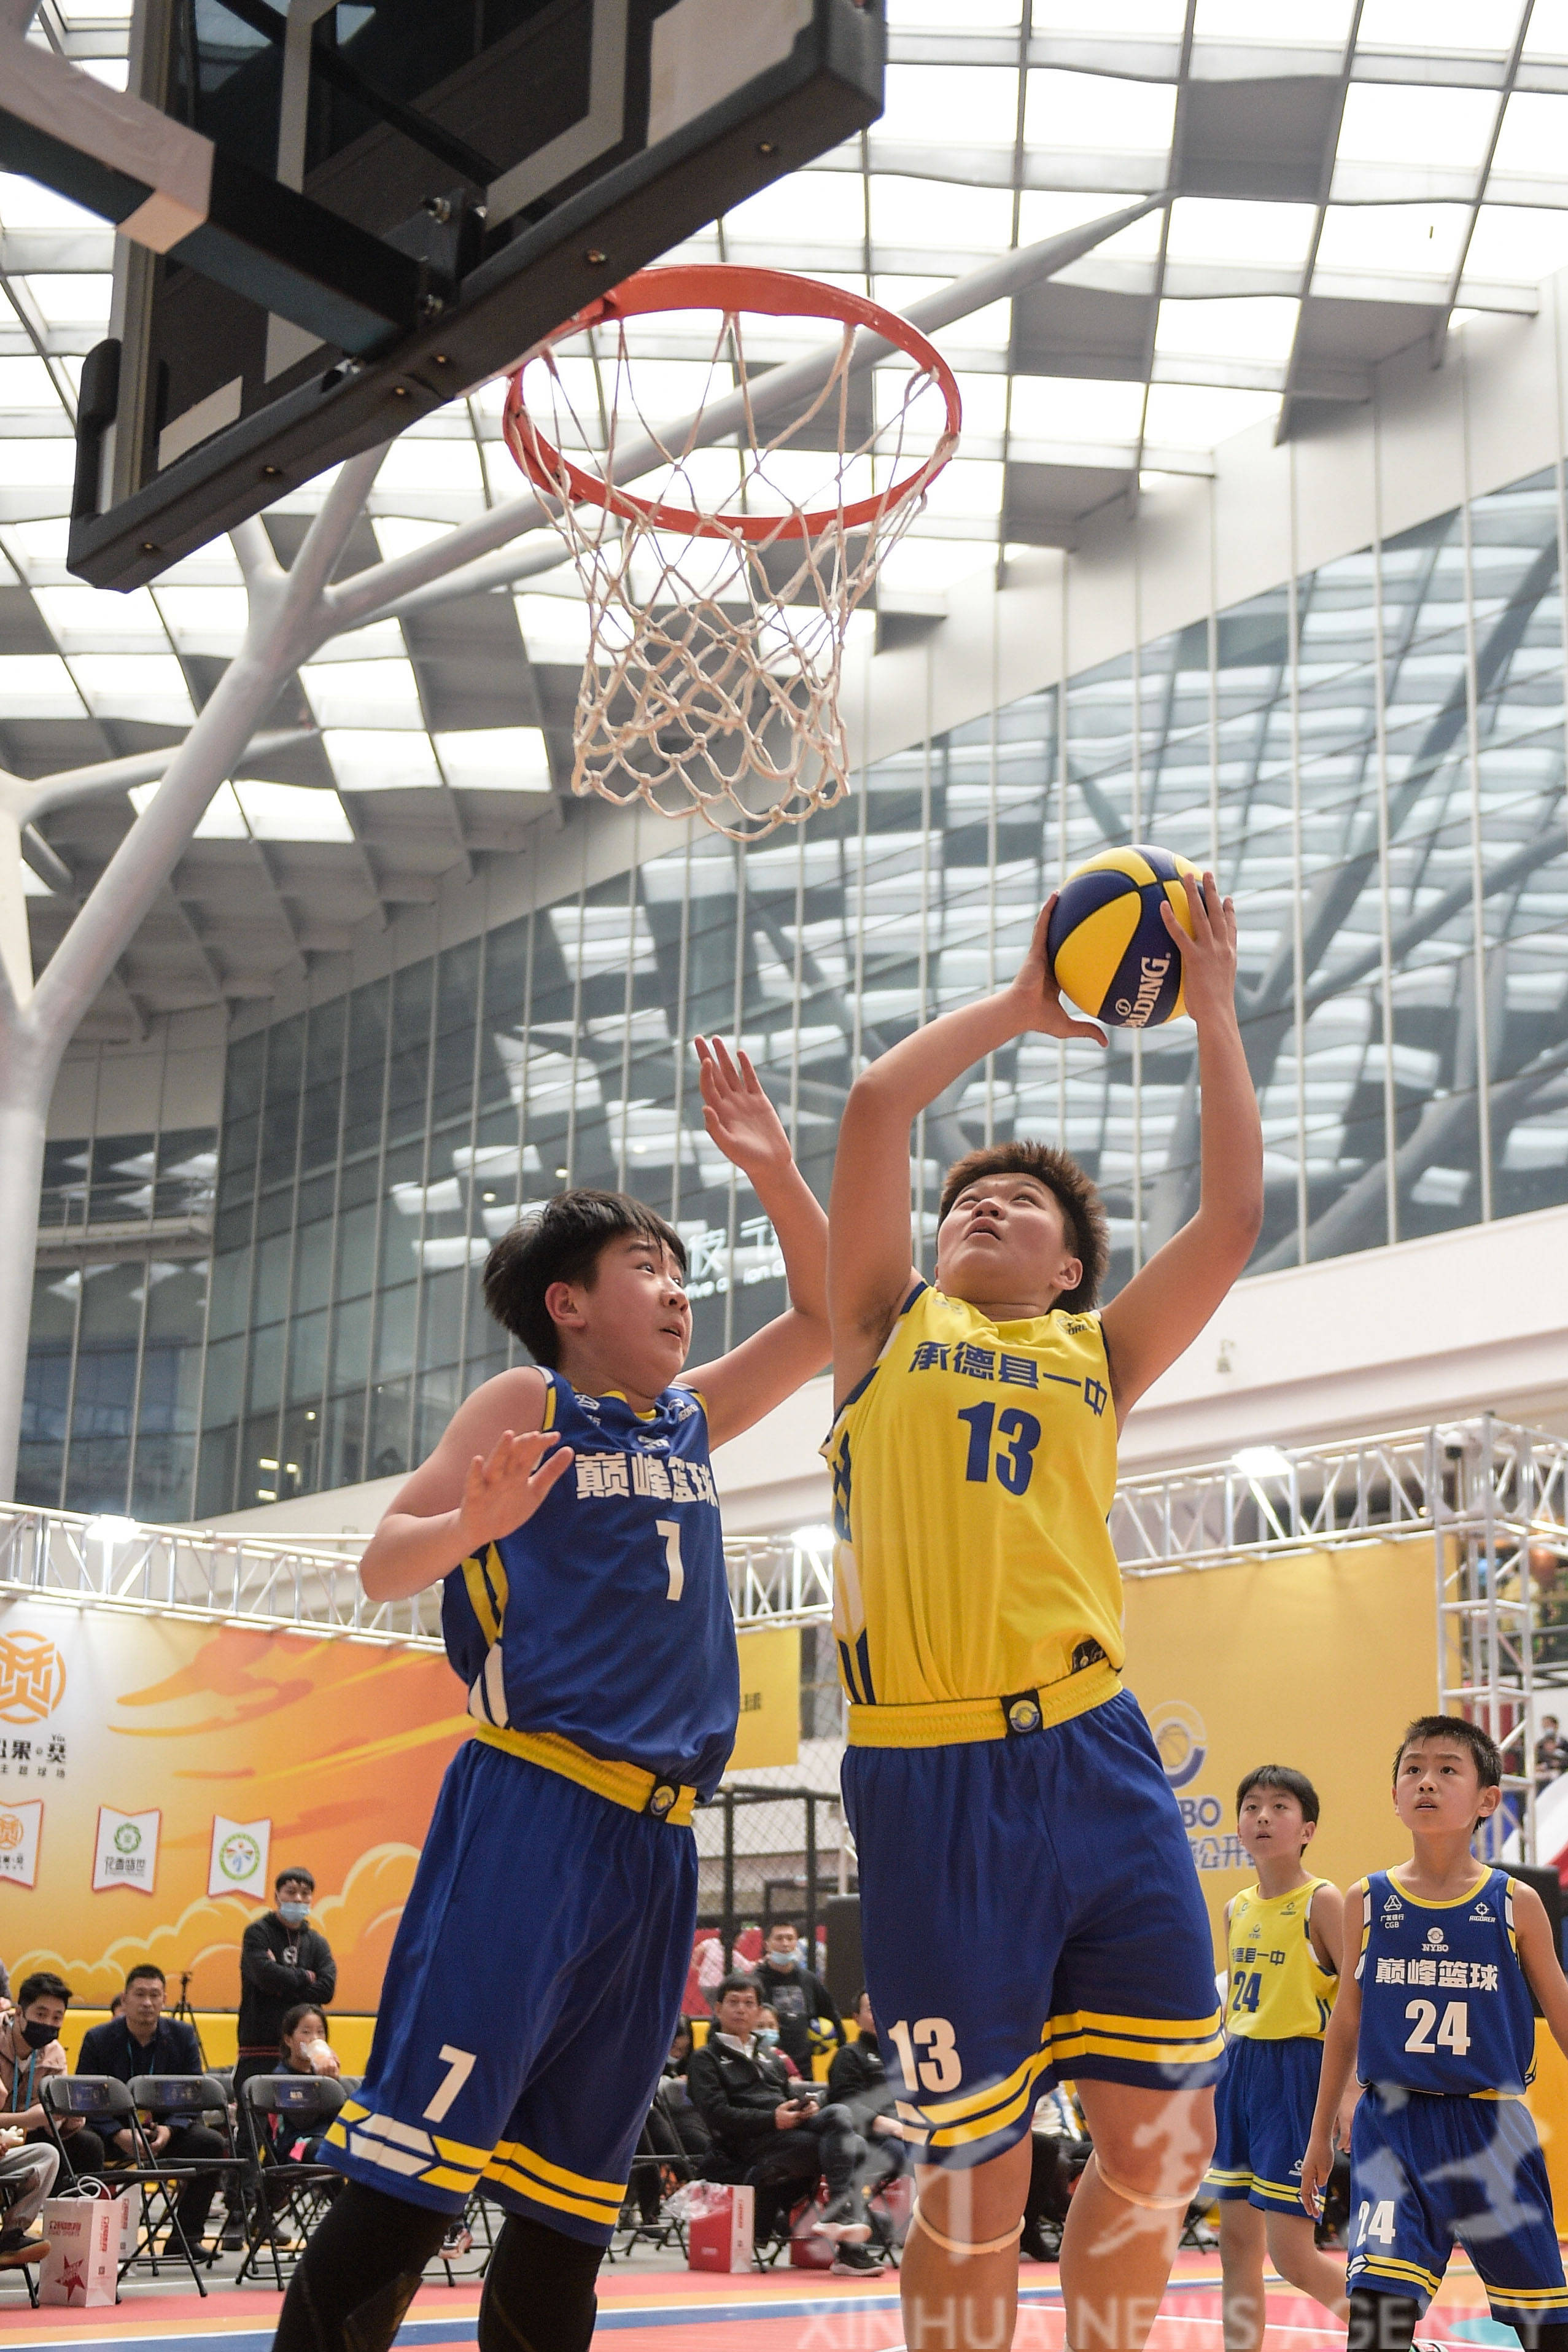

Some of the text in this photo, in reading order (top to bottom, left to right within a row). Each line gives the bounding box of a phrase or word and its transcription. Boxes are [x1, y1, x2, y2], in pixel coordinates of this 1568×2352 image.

[908, 1340, 1108, 1417] 承德县一中
[957, 1400, 1042, 1496] 13
[575, 1451, 719, 1508] 巅峰篮球
[656, 1519, 685, 1601] 7
[1375, 1957, 1498, 1992] 巅峰篮球
[1421, 1943, 1449, 1952] NYBO
[1232, 1970, 1262, 2013] 24
[887, 2017, 962, 2093] 13
[1405, 1999, 1470, 2055] 24
[422, 2044, 476, 2123] 7
[1356, 2200, 1395, 2247] 24
